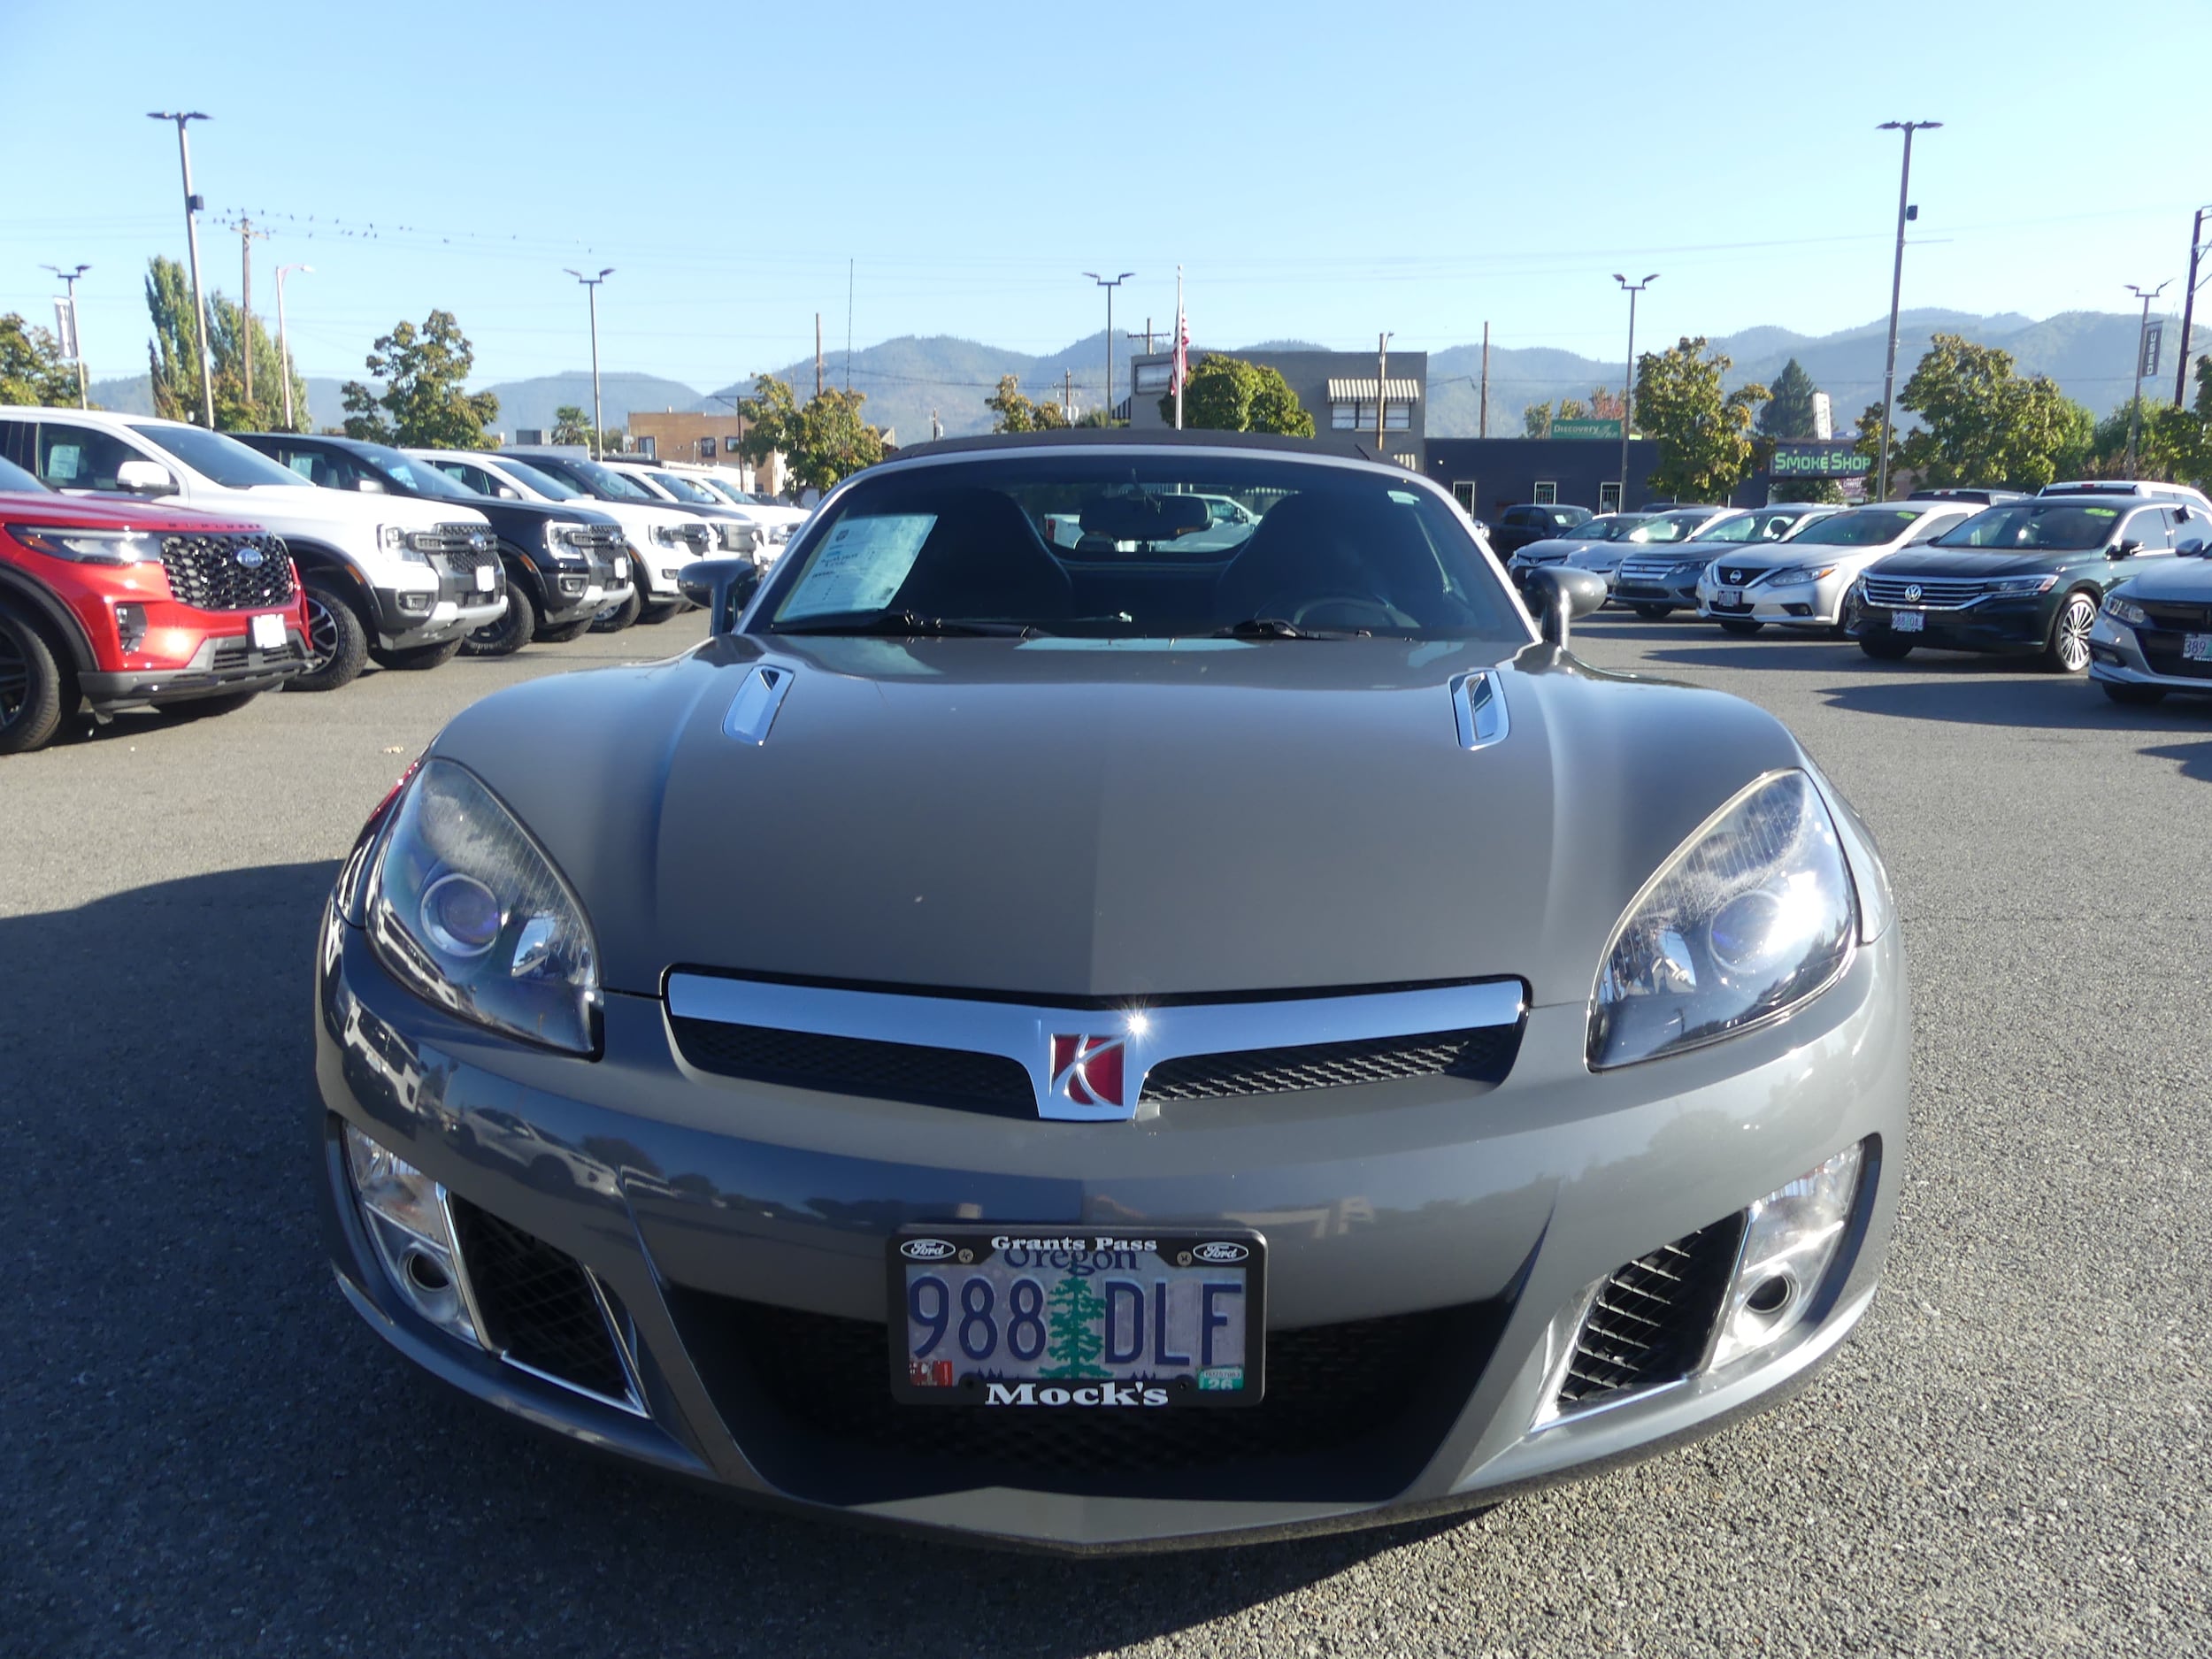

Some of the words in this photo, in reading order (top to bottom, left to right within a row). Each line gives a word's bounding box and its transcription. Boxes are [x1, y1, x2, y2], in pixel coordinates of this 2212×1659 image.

[2147, 331, 2157, 375] USED
[1554, 425, 1599, 435] Discovery
[2185, 641, 2207, 654] 389
[910, 1241, 945, 1256] Ford
[991, 1236, 1086, 1251] Grants
[1094, 1237, 1157, 1251] Pass
[1202, 1244, 1238, 1259] Ford
[1003, 1248, 1141, 1276] Oregon
[909, 1276, 1047, 1361] 988
[1104, 1280, 1242, 1365] DLF
[985, 1381, 1169, 1406] Mock's
